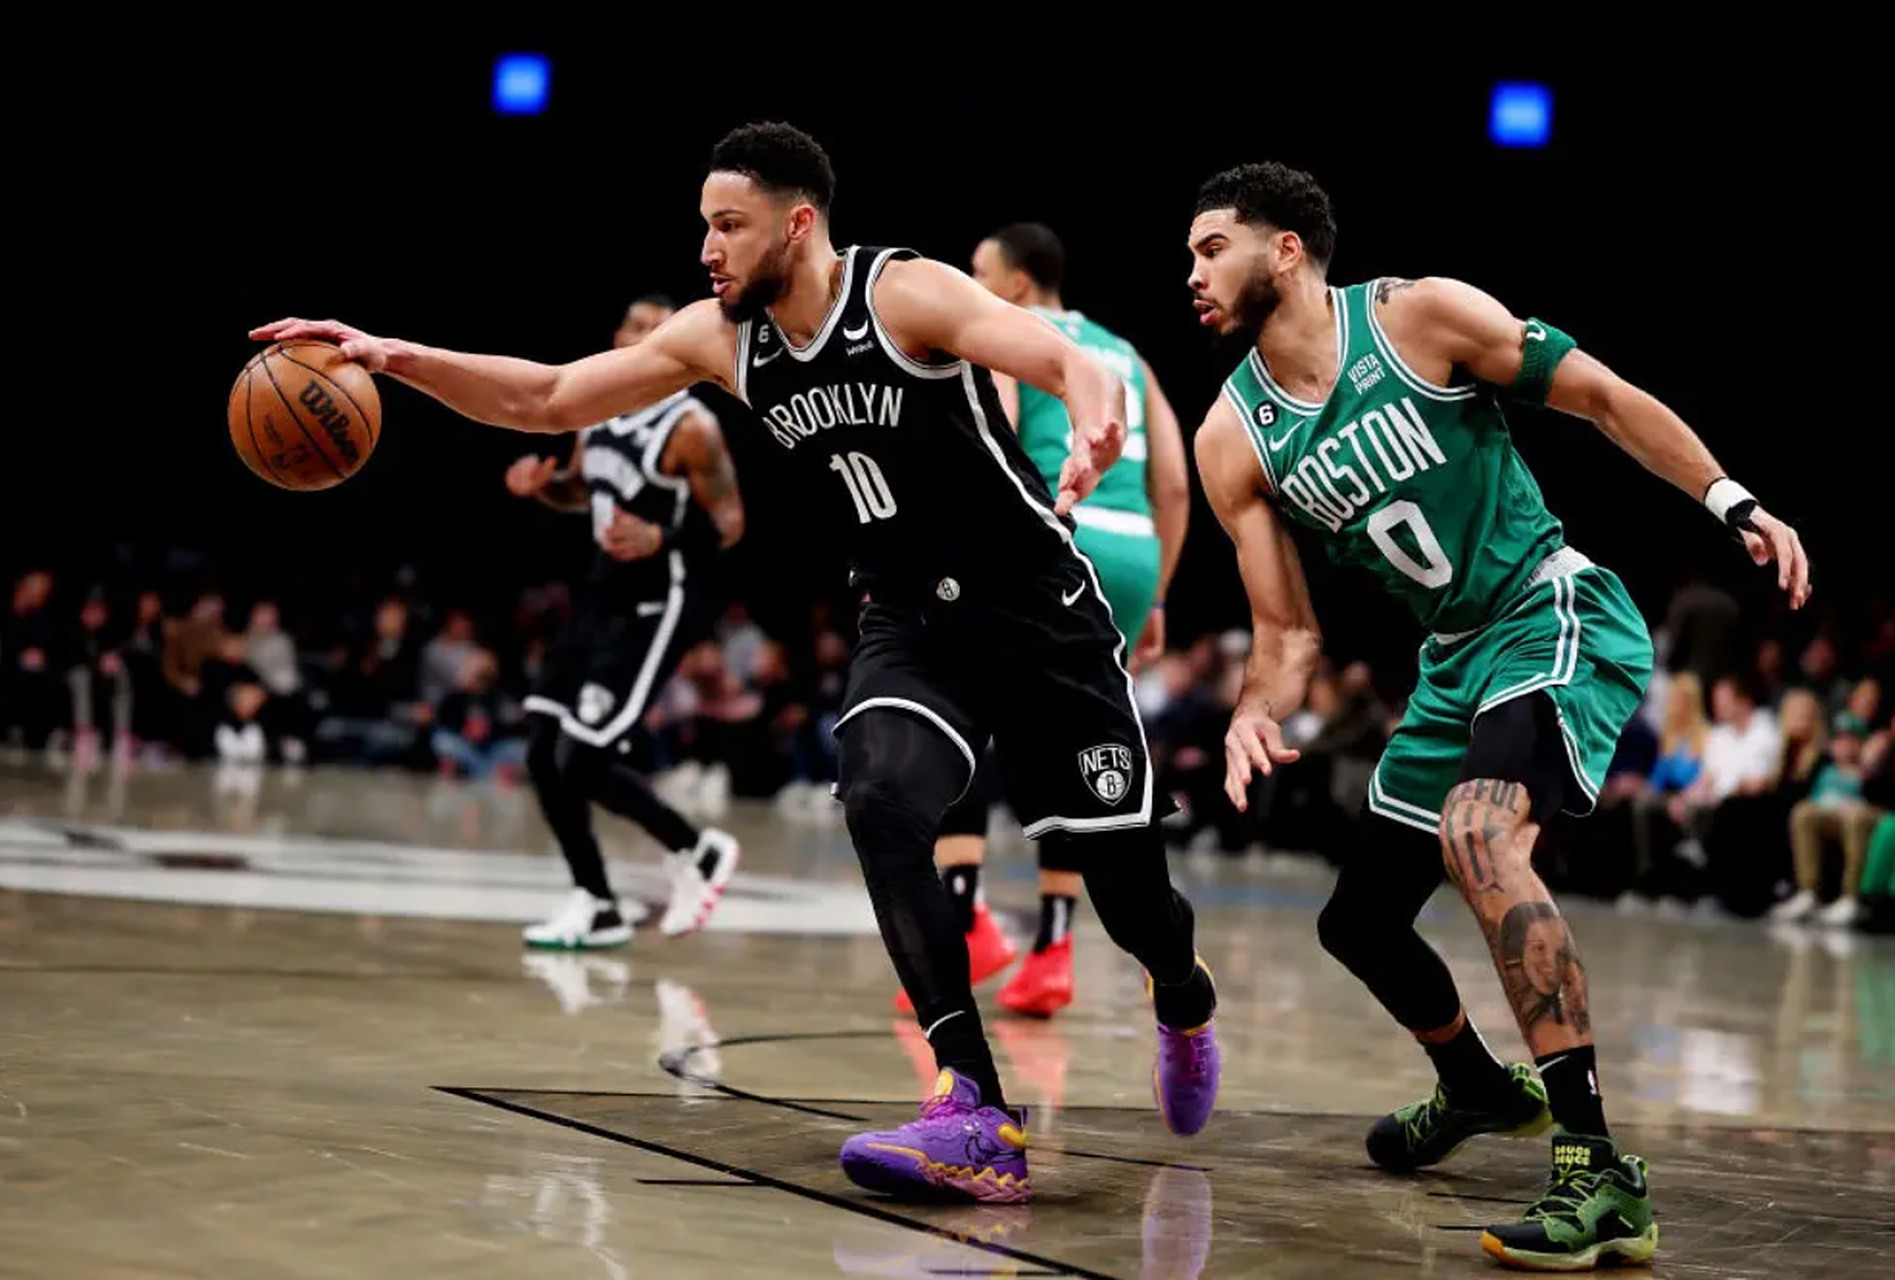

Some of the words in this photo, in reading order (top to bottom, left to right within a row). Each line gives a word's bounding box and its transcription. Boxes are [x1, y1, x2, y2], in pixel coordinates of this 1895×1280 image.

[758, 324, 769, 344] 6
[1347, 353, 1380, 383] VISTA
[1355, 367, 1386, 395] PRINT
[762, 382, 903, 449] BROOKLYN
[1259, 404, 1275, 425] 6
[1281, 397, 1447, 533] BOSTON
[829, 452, 897, 524] 10
[1367, 500, 1453, 589] 0
[1083, 748, 1130, 775] NETS
